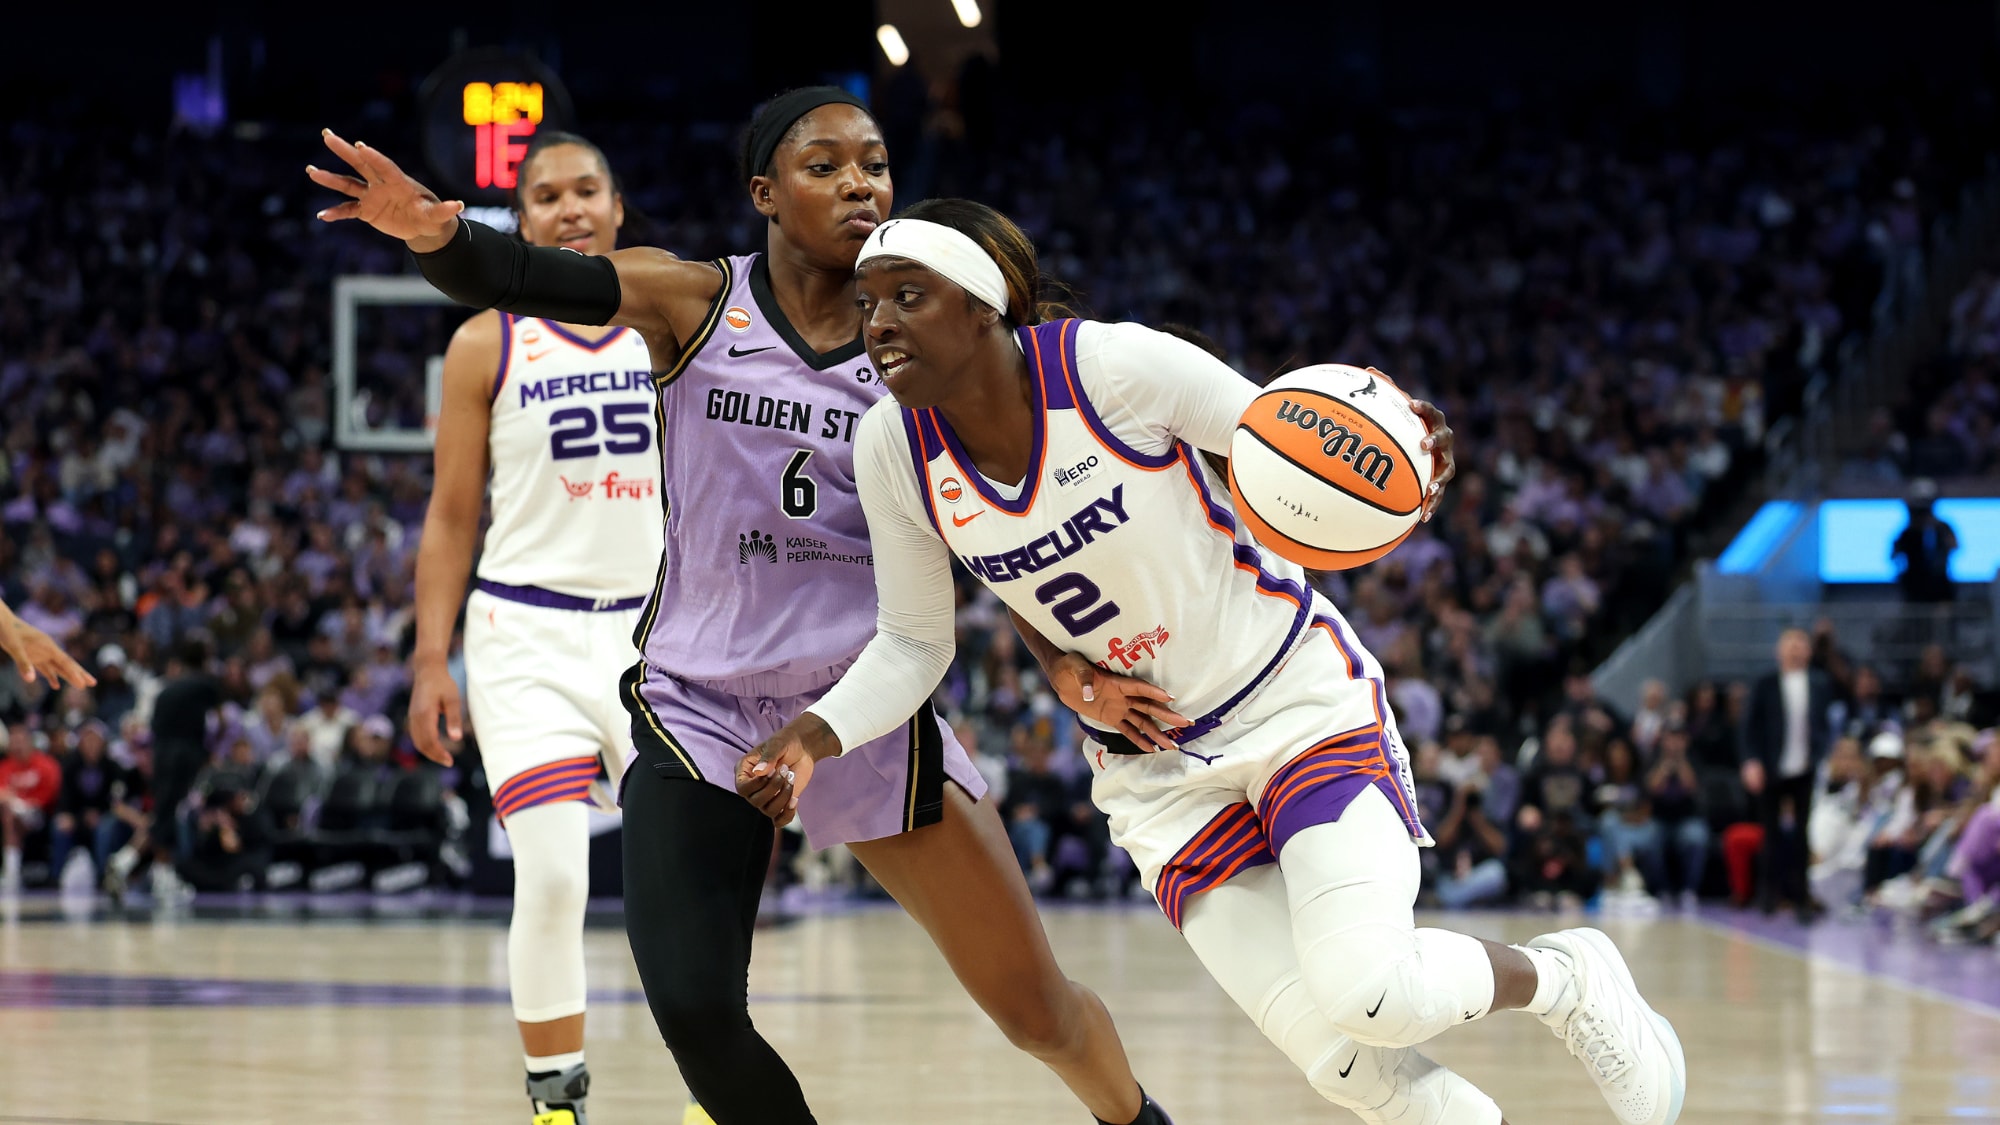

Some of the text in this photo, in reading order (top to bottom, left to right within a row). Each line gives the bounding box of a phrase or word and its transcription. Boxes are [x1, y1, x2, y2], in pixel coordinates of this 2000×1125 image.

[549, 403, 651, 460] 25
[706, 388, 812, 434] GOLDEN
[1054, 455, 1098, 487] HERO
[1276, 400, 1395, 492] Wilson
[781, 449, 817, 519] 6
[786, 537, 828, 549] KAISER
[962, 482, 1130, 583] MERCURY
[787, 551, 874, 566] PERMANENTE
[1035, 571, 1121, 638] 2
[1108, 627, 1170, 670] fry's
